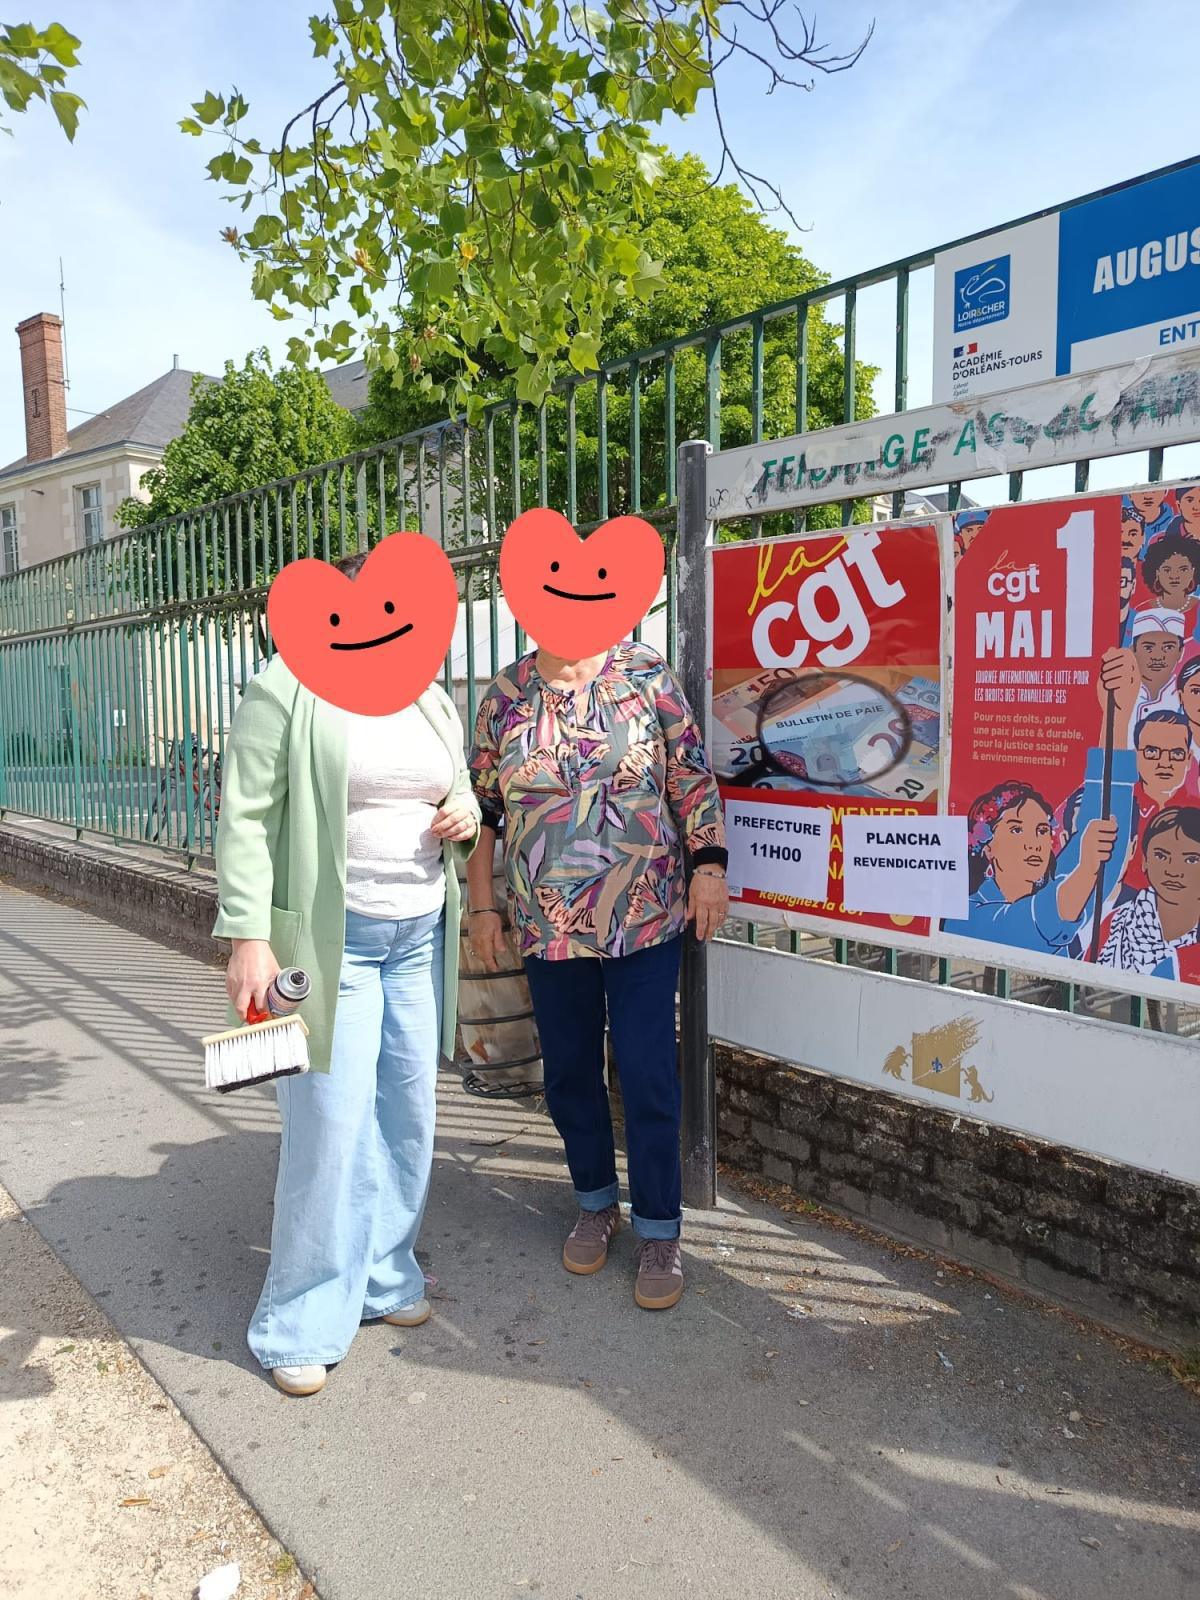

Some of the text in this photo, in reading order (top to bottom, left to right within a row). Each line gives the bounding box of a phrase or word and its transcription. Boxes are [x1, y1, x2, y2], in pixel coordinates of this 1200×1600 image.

[957, 301, 1005, 322] LOIR&CHER
[1159, 320, 1200, 345] ENT
[952, 350, 1003, 370] ACADÉMIE
[952, 350, 1043, 381] D'ORLÉANS-TOURS
[988, 549, 1039, 572] la
[748, 535, 848, 616] la
[987, 563, 1040, 603] cgt
[1056, 510, 1095, 658] 1
[752, 531, 907, 668] cgt
[975, 610, 1053, 659] MAI
[998, 669, 1044, 684] INTERNATIONALE
[1054, 670, 1072, 685] LUTTE
[1073, 670, 1090, 685] POUR
[974, 687, 984, 702] LES
[984, 688, 1004, 702] DROITS
[1004, 688, 1016, 702] DES
[775, 704, 885, 729] BULLETIN DE PAIE
[973, 711, 994, 721] Pour
[995, 713, 1012, 723] nos
[1044, 715, 1067, 725] pour
[973, 726, 990, 735] une
[991, 726, 1010, 737] paix
[1011, 727, 1035, 738] juste
[973, 739, 1069, 753] pour la justice sociale
[895, 778, 925, 800] 20
[733, 815, 821, 836] PREFECTURE
[866, 832, 942, 847] PLANCHA
[750, 842, 802, 863] 11H00
[853, 856, 957, 871] REVENDICATIVE
